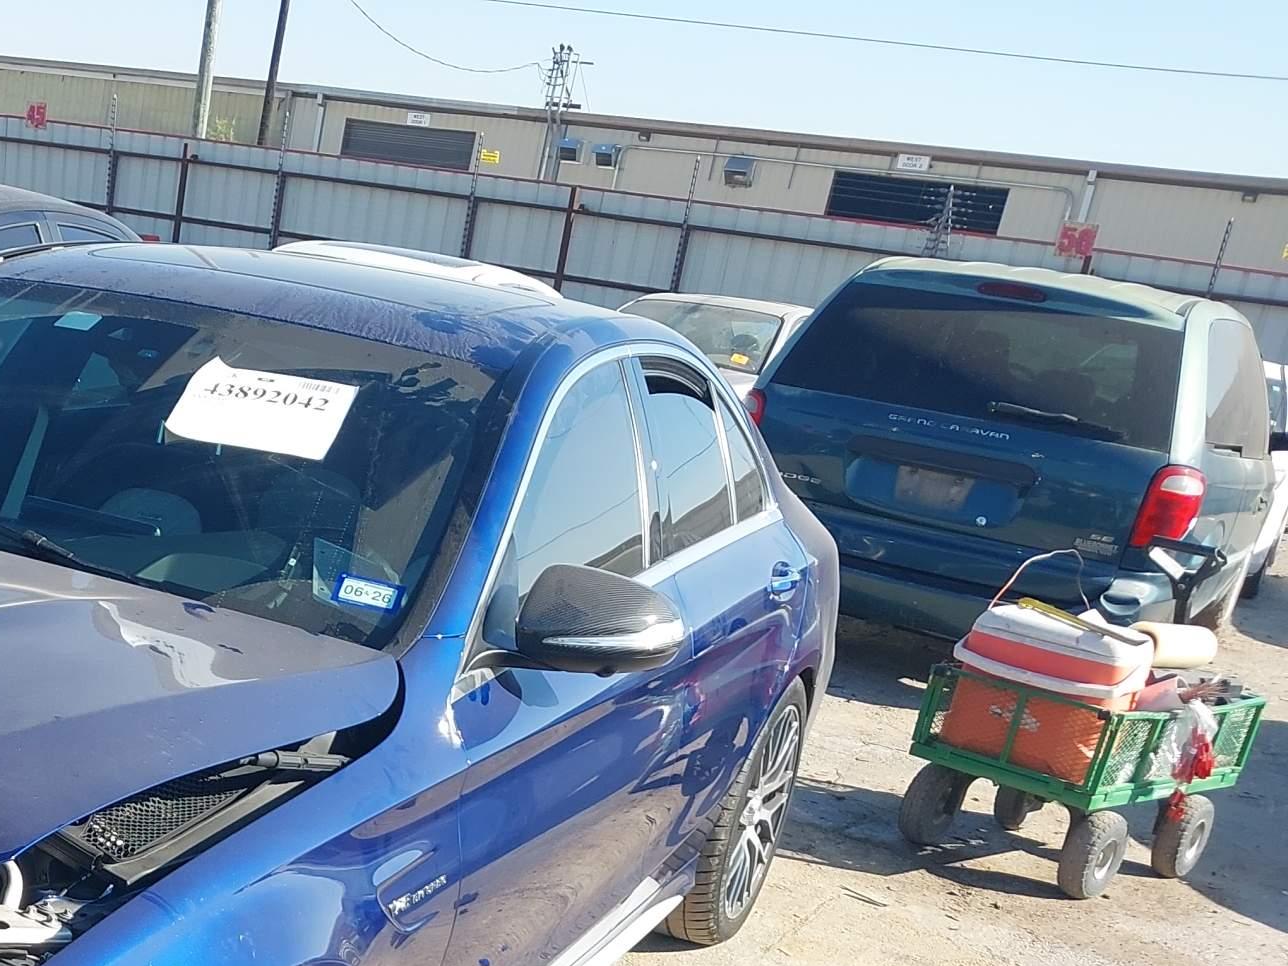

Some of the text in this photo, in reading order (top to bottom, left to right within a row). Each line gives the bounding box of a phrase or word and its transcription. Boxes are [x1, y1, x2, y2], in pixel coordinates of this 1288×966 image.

[26, 102, 47, 128] 45
[204, 382, 329, 412] 43892042
[344, 584, 393, 604] 06 26
